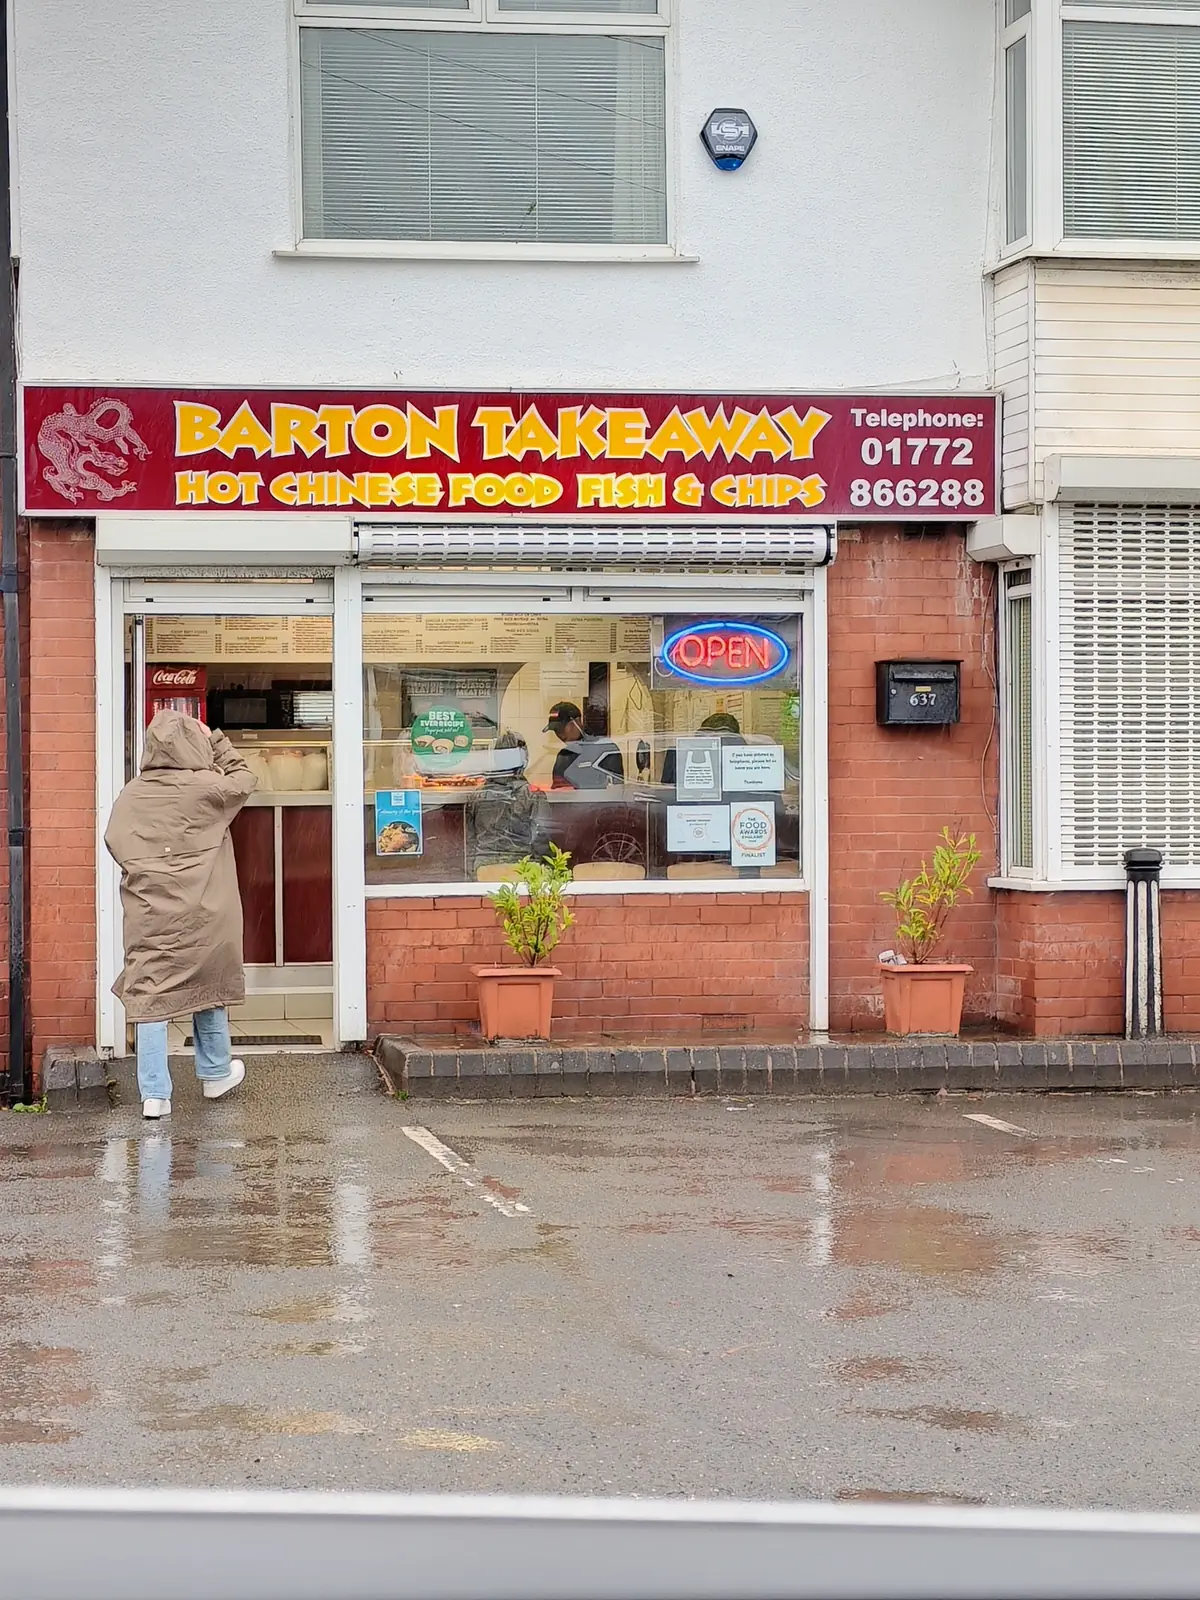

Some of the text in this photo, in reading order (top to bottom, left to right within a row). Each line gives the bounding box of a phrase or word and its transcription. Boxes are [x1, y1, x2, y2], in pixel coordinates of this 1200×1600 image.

[173, 399, 832, 463] BARTON TAKEAWAY
[850, 408, 985, 431] Telephone:
[860, 438, 974, 466] 01772
[174, 470, 828, 508] HOT CHINESE FOOD FISH & CHIPS
[849, 478, 985, 508] 866288
[679, 634, 770, 669] OPEN
[152, 669, 198, 685] Coca-Cola
[909, 693, 936, 706] 637
[429, 711, 456, 720] BEST
